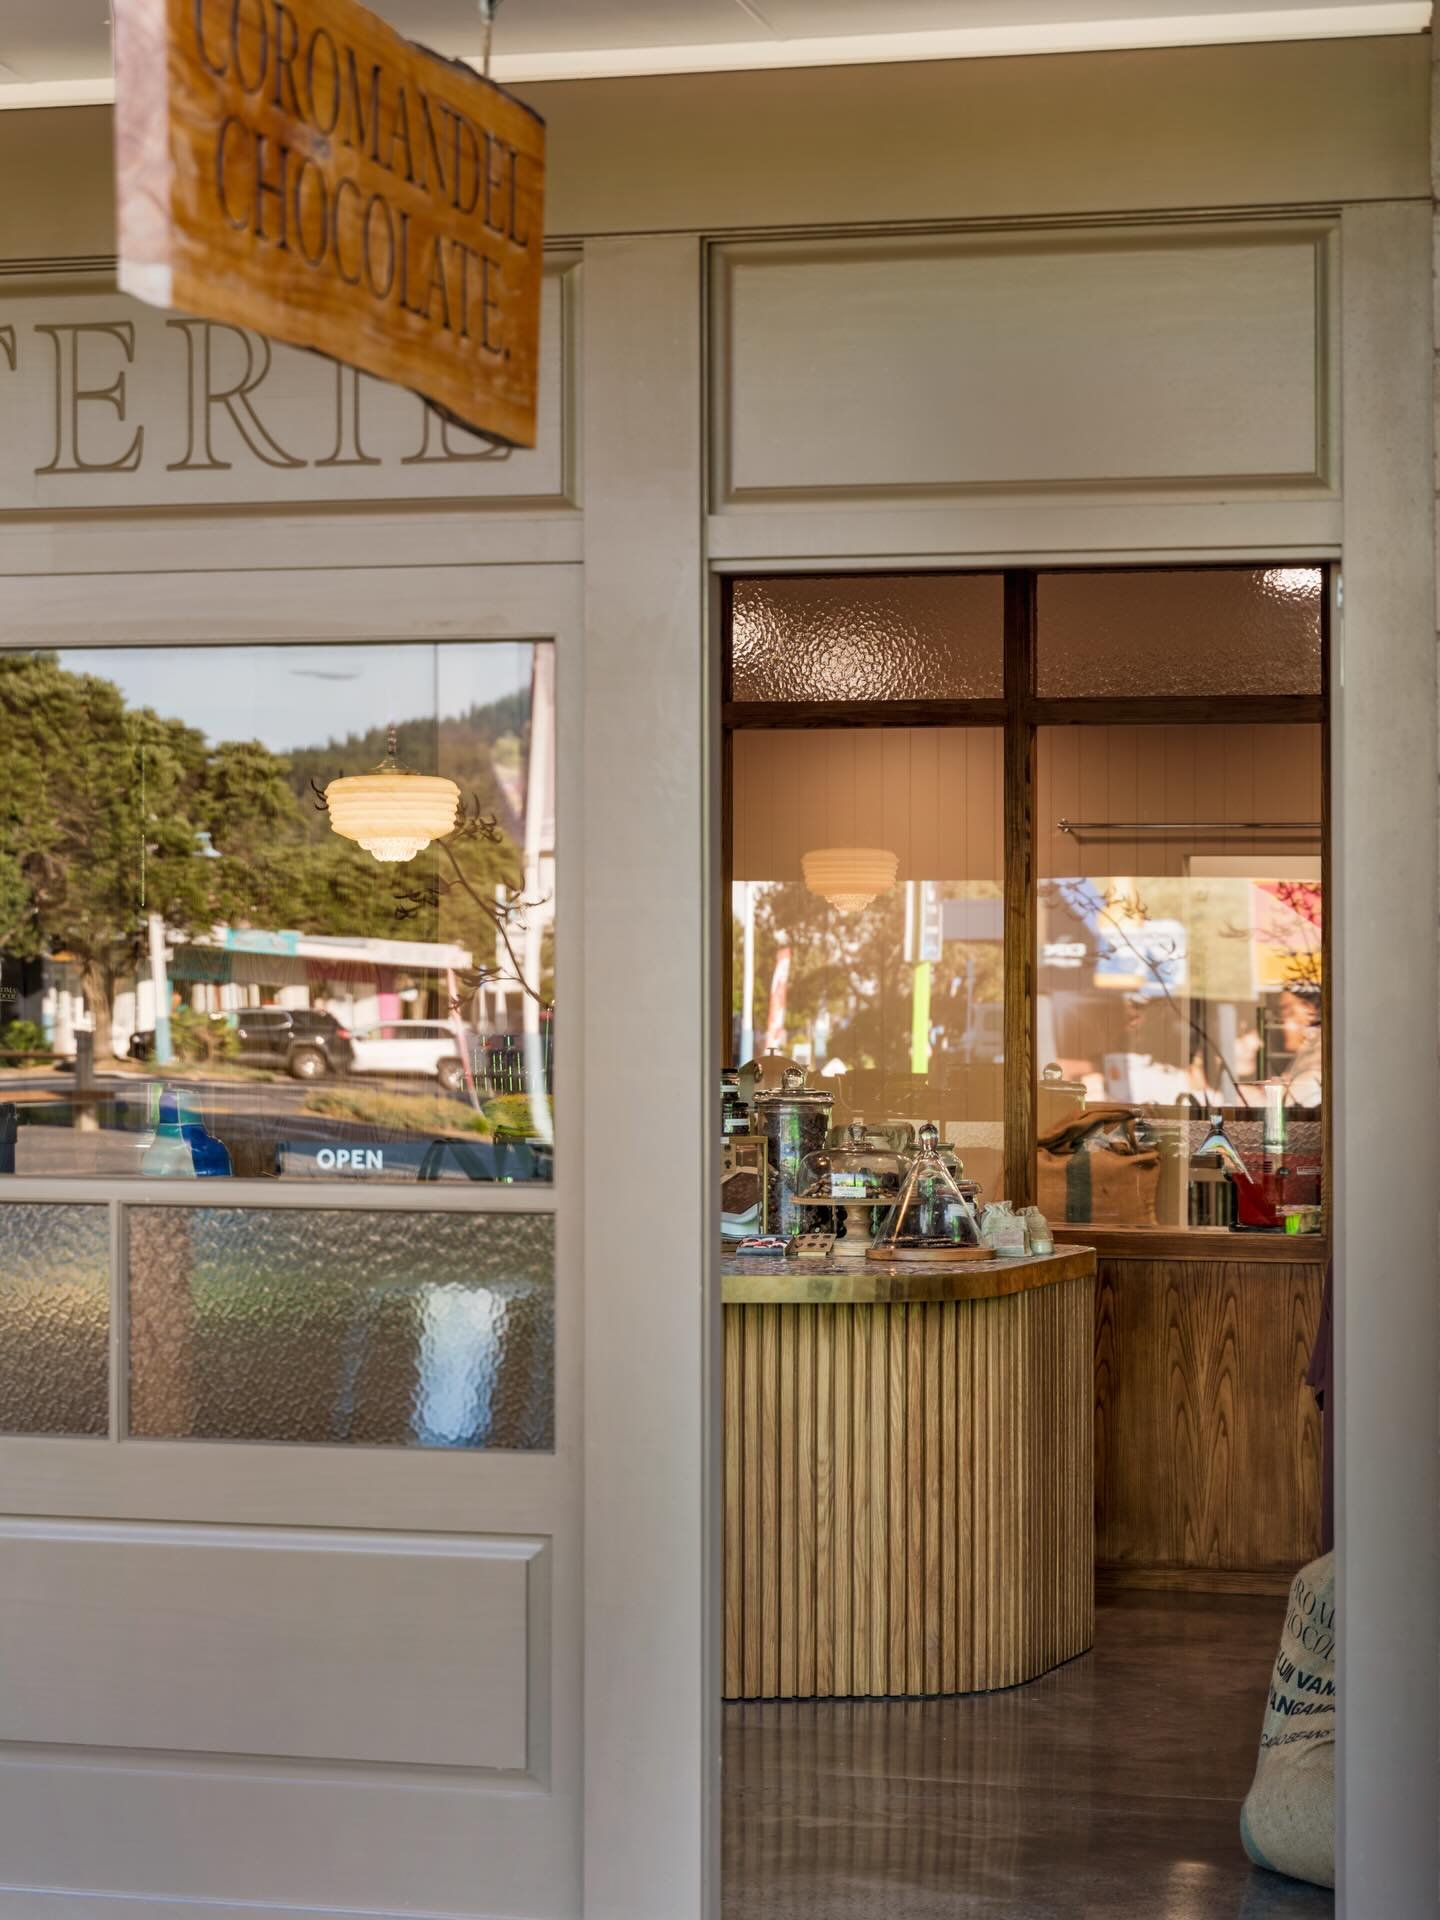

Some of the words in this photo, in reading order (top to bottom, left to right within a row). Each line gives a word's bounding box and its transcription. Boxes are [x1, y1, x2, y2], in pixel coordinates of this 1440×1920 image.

[194, 0, 528, 248] COROMANDEL
[316, 1148, 383, 1169] OPEN
[1297, 1672, 1335, 1696] VAN
